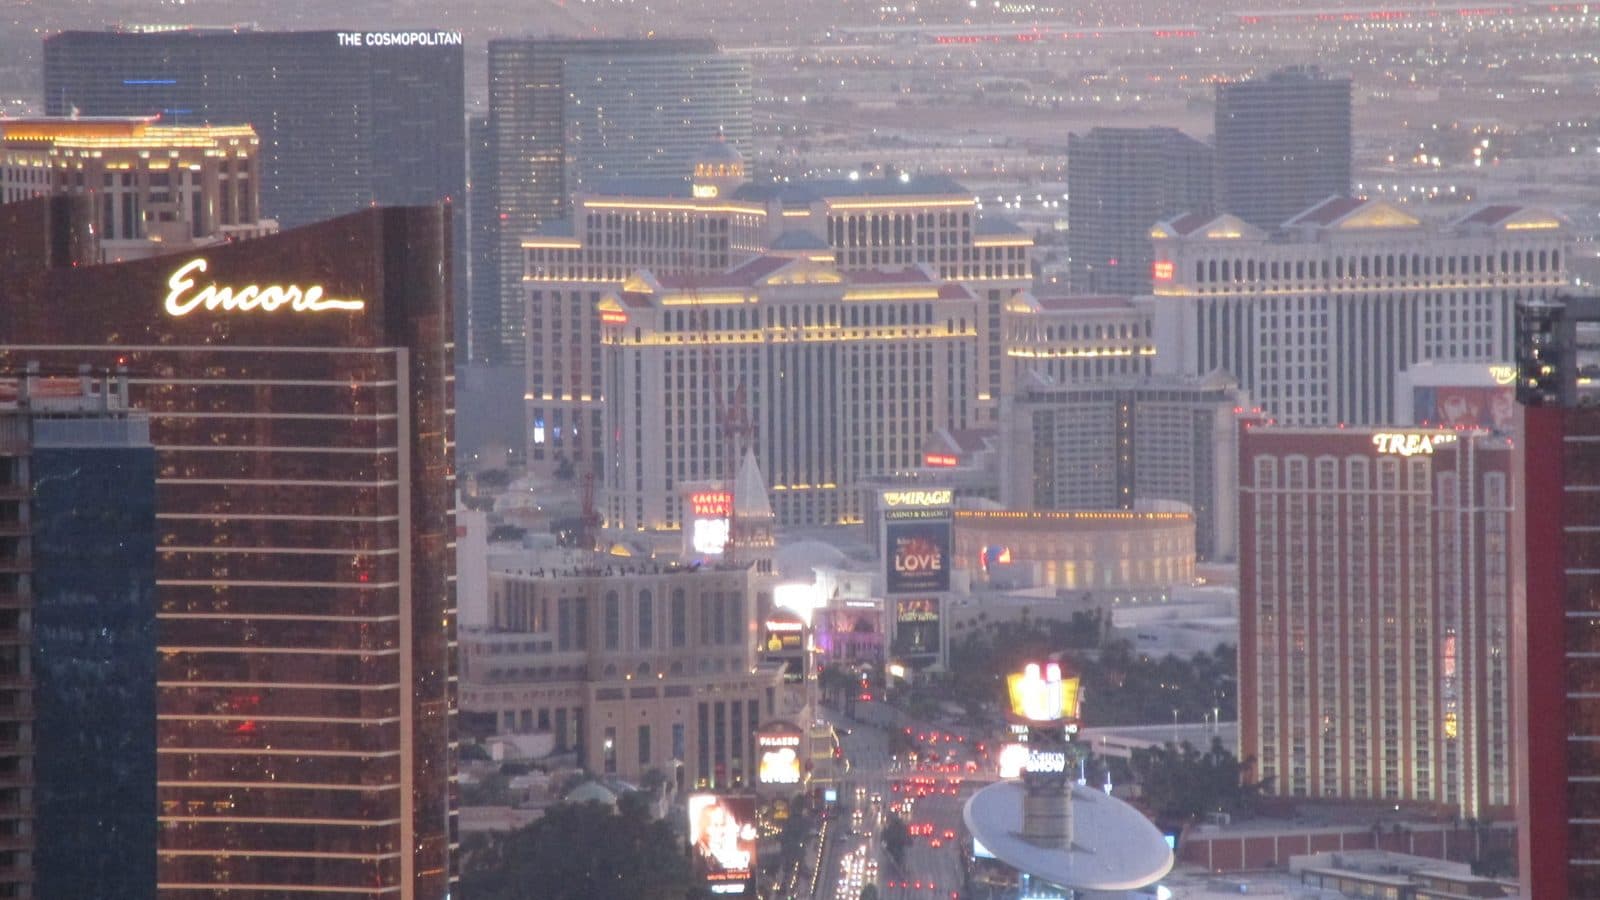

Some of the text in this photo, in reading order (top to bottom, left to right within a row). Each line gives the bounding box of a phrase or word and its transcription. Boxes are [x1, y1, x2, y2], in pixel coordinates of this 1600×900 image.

[337, 31, 462, 46] THE COSMOPOLITAN
[165, 258, 365, 316] Encore
[900, 490, 951, 506] MIRAGE
[895, 554, 942, 571] LOVE
[759, 736, 800, 746] PALAZZO
